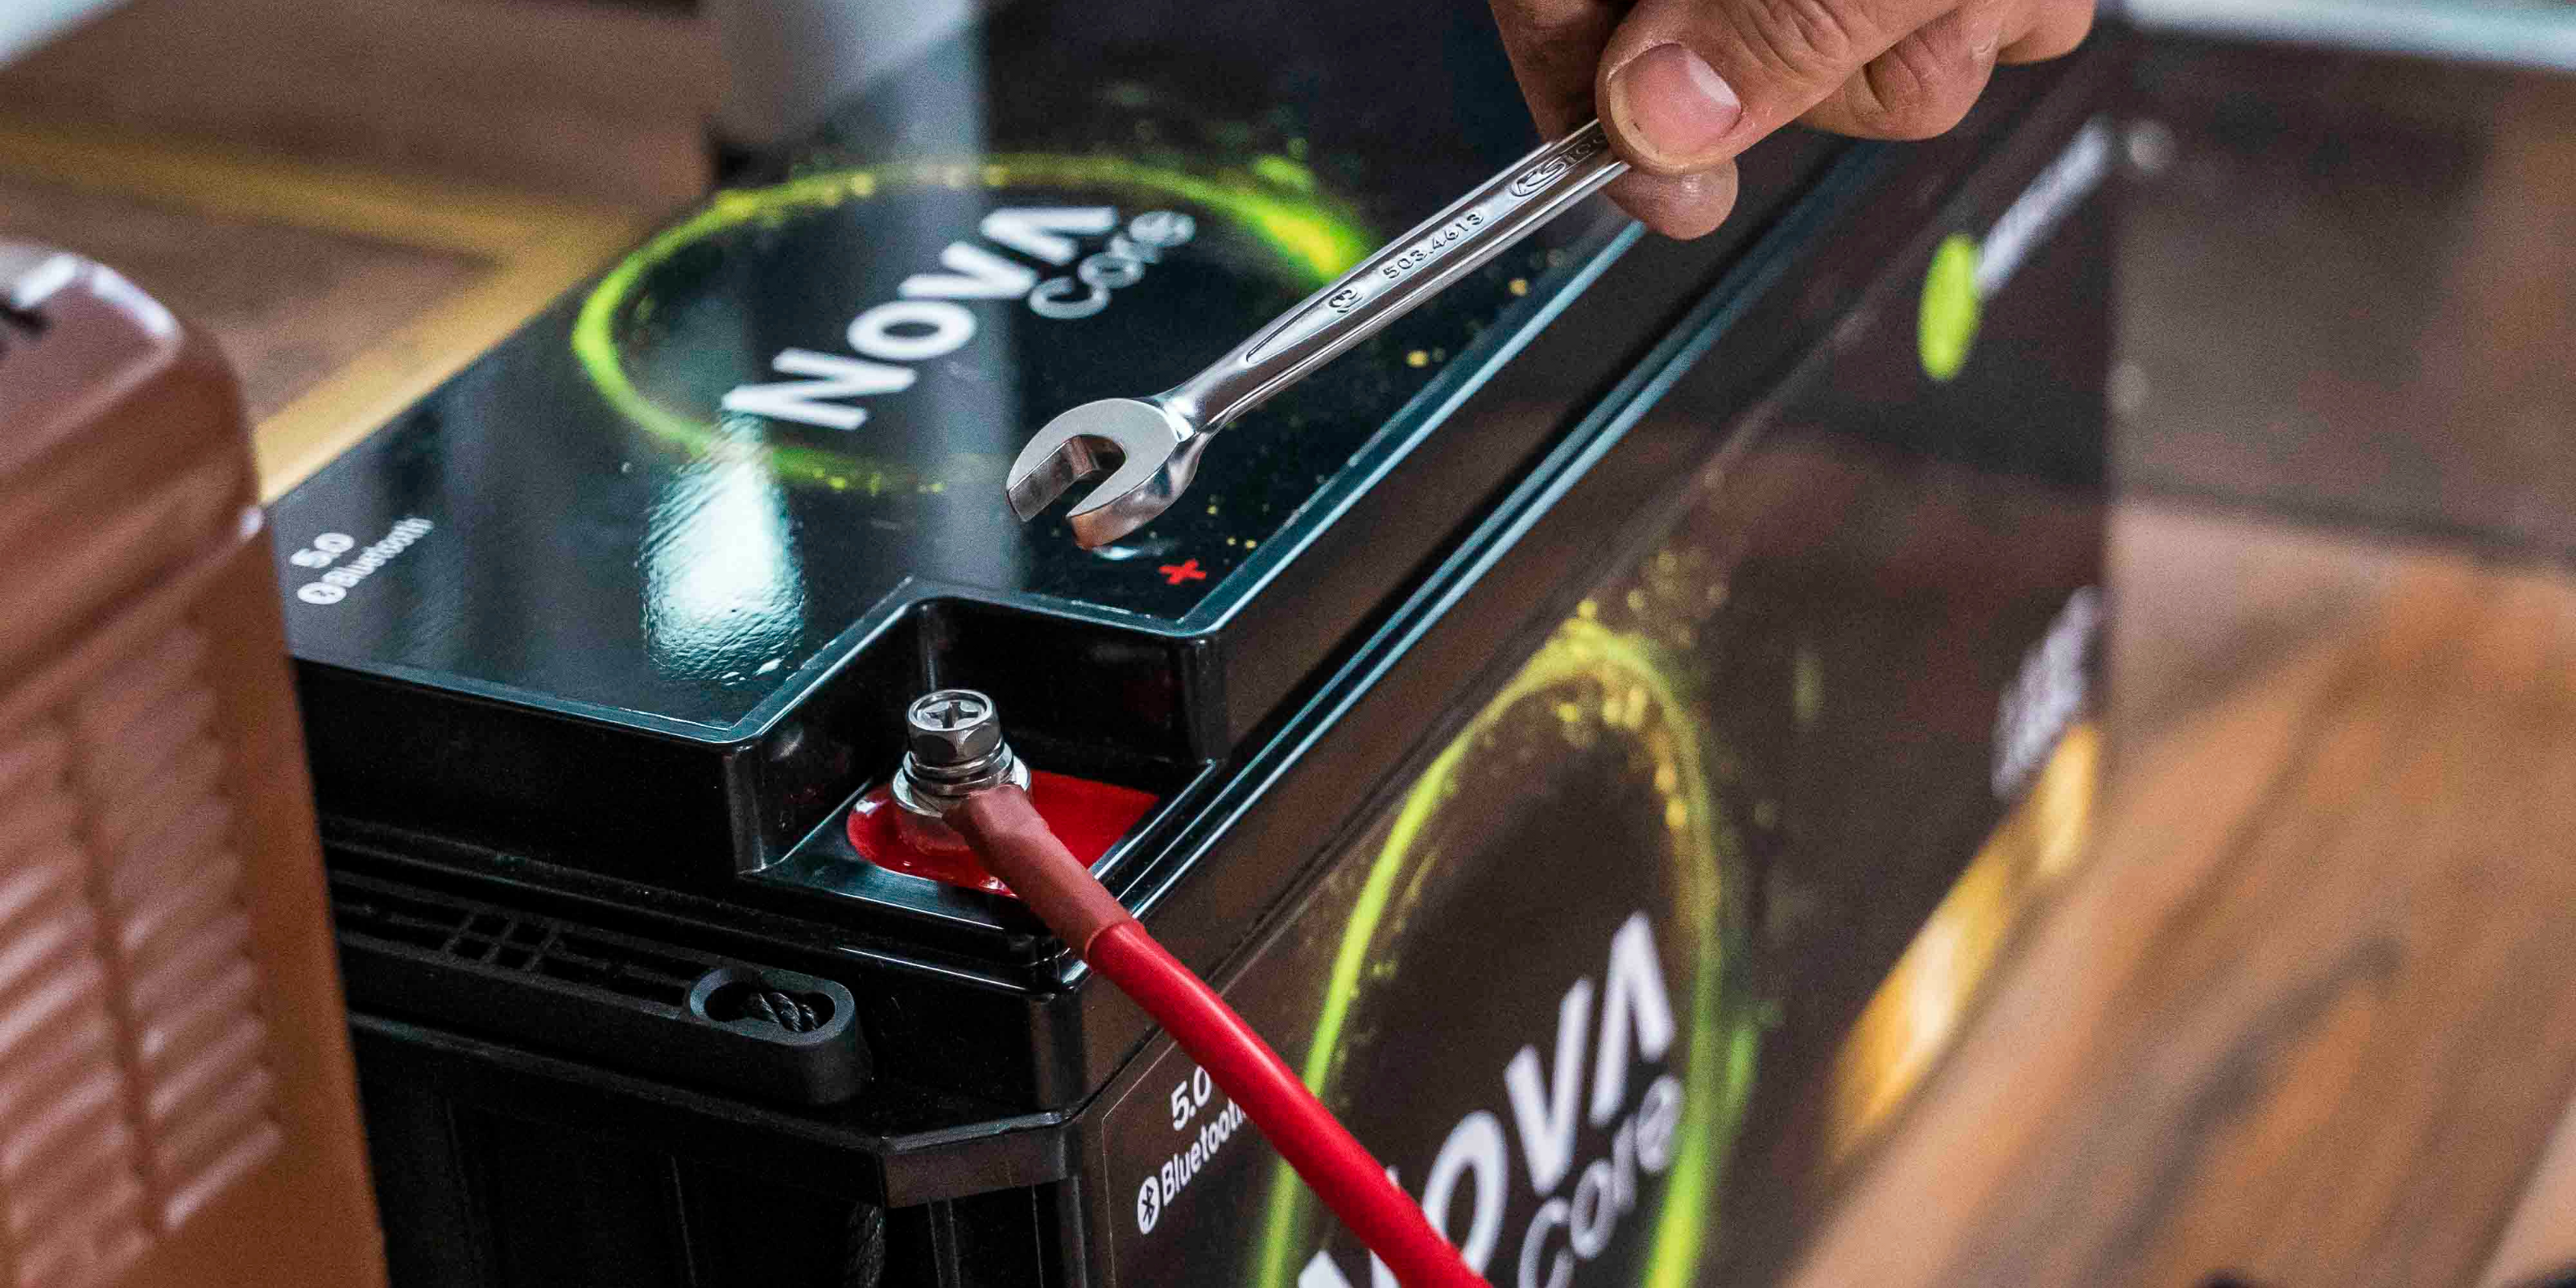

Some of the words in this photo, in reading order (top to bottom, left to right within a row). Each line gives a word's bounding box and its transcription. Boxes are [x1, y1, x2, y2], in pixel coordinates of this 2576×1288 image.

[1028, 210, 1197, 320] Core
[1382, 210, 1485, 280] 503.4613
[720, 205, 1119, 431] NOVA
[1170, 1065, 1213, 1132] 5.0
